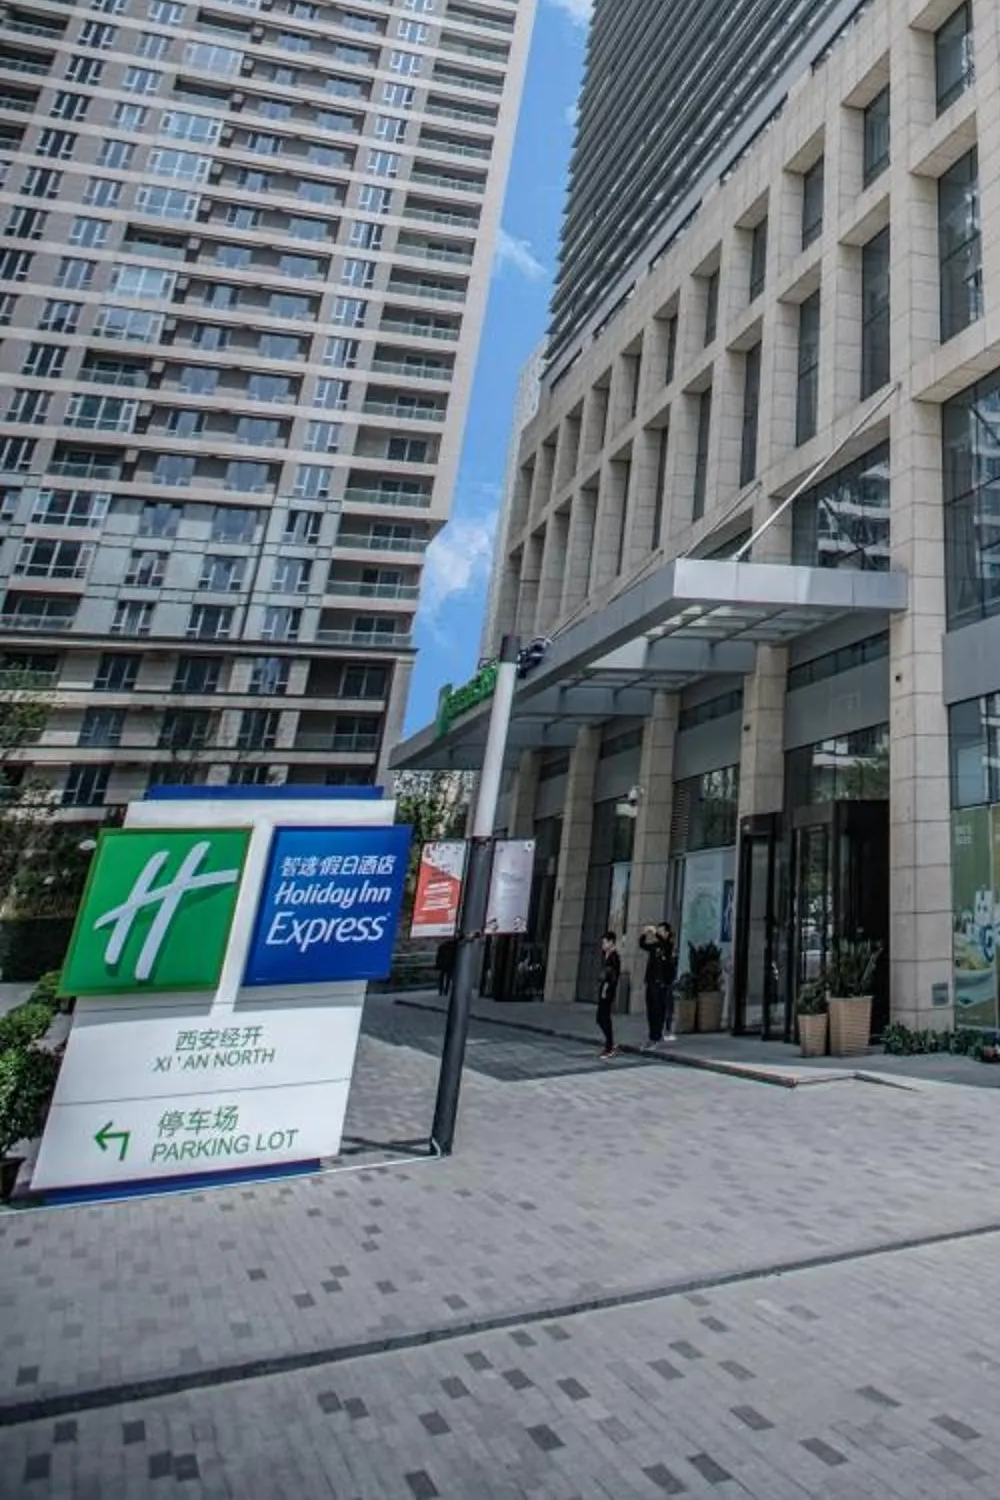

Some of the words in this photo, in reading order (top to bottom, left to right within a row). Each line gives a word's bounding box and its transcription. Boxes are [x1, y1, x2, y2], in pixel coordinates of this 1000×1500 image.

[281, 854, 397, 877] 智选假日酒店
[274, 881, 359, 909] Holiday
[360, 880, 392, 903] Inn
[265, 911, 387, 953] Express
[175, 1025, 264, 1051] 西安经开
[212, 1048, 275, 1067] NORTH
[158, 1105, 239, 1138] 停车场
[151, 1134, 251, 1163] PARKING
[254, 1128, 299, 1152] LOT
